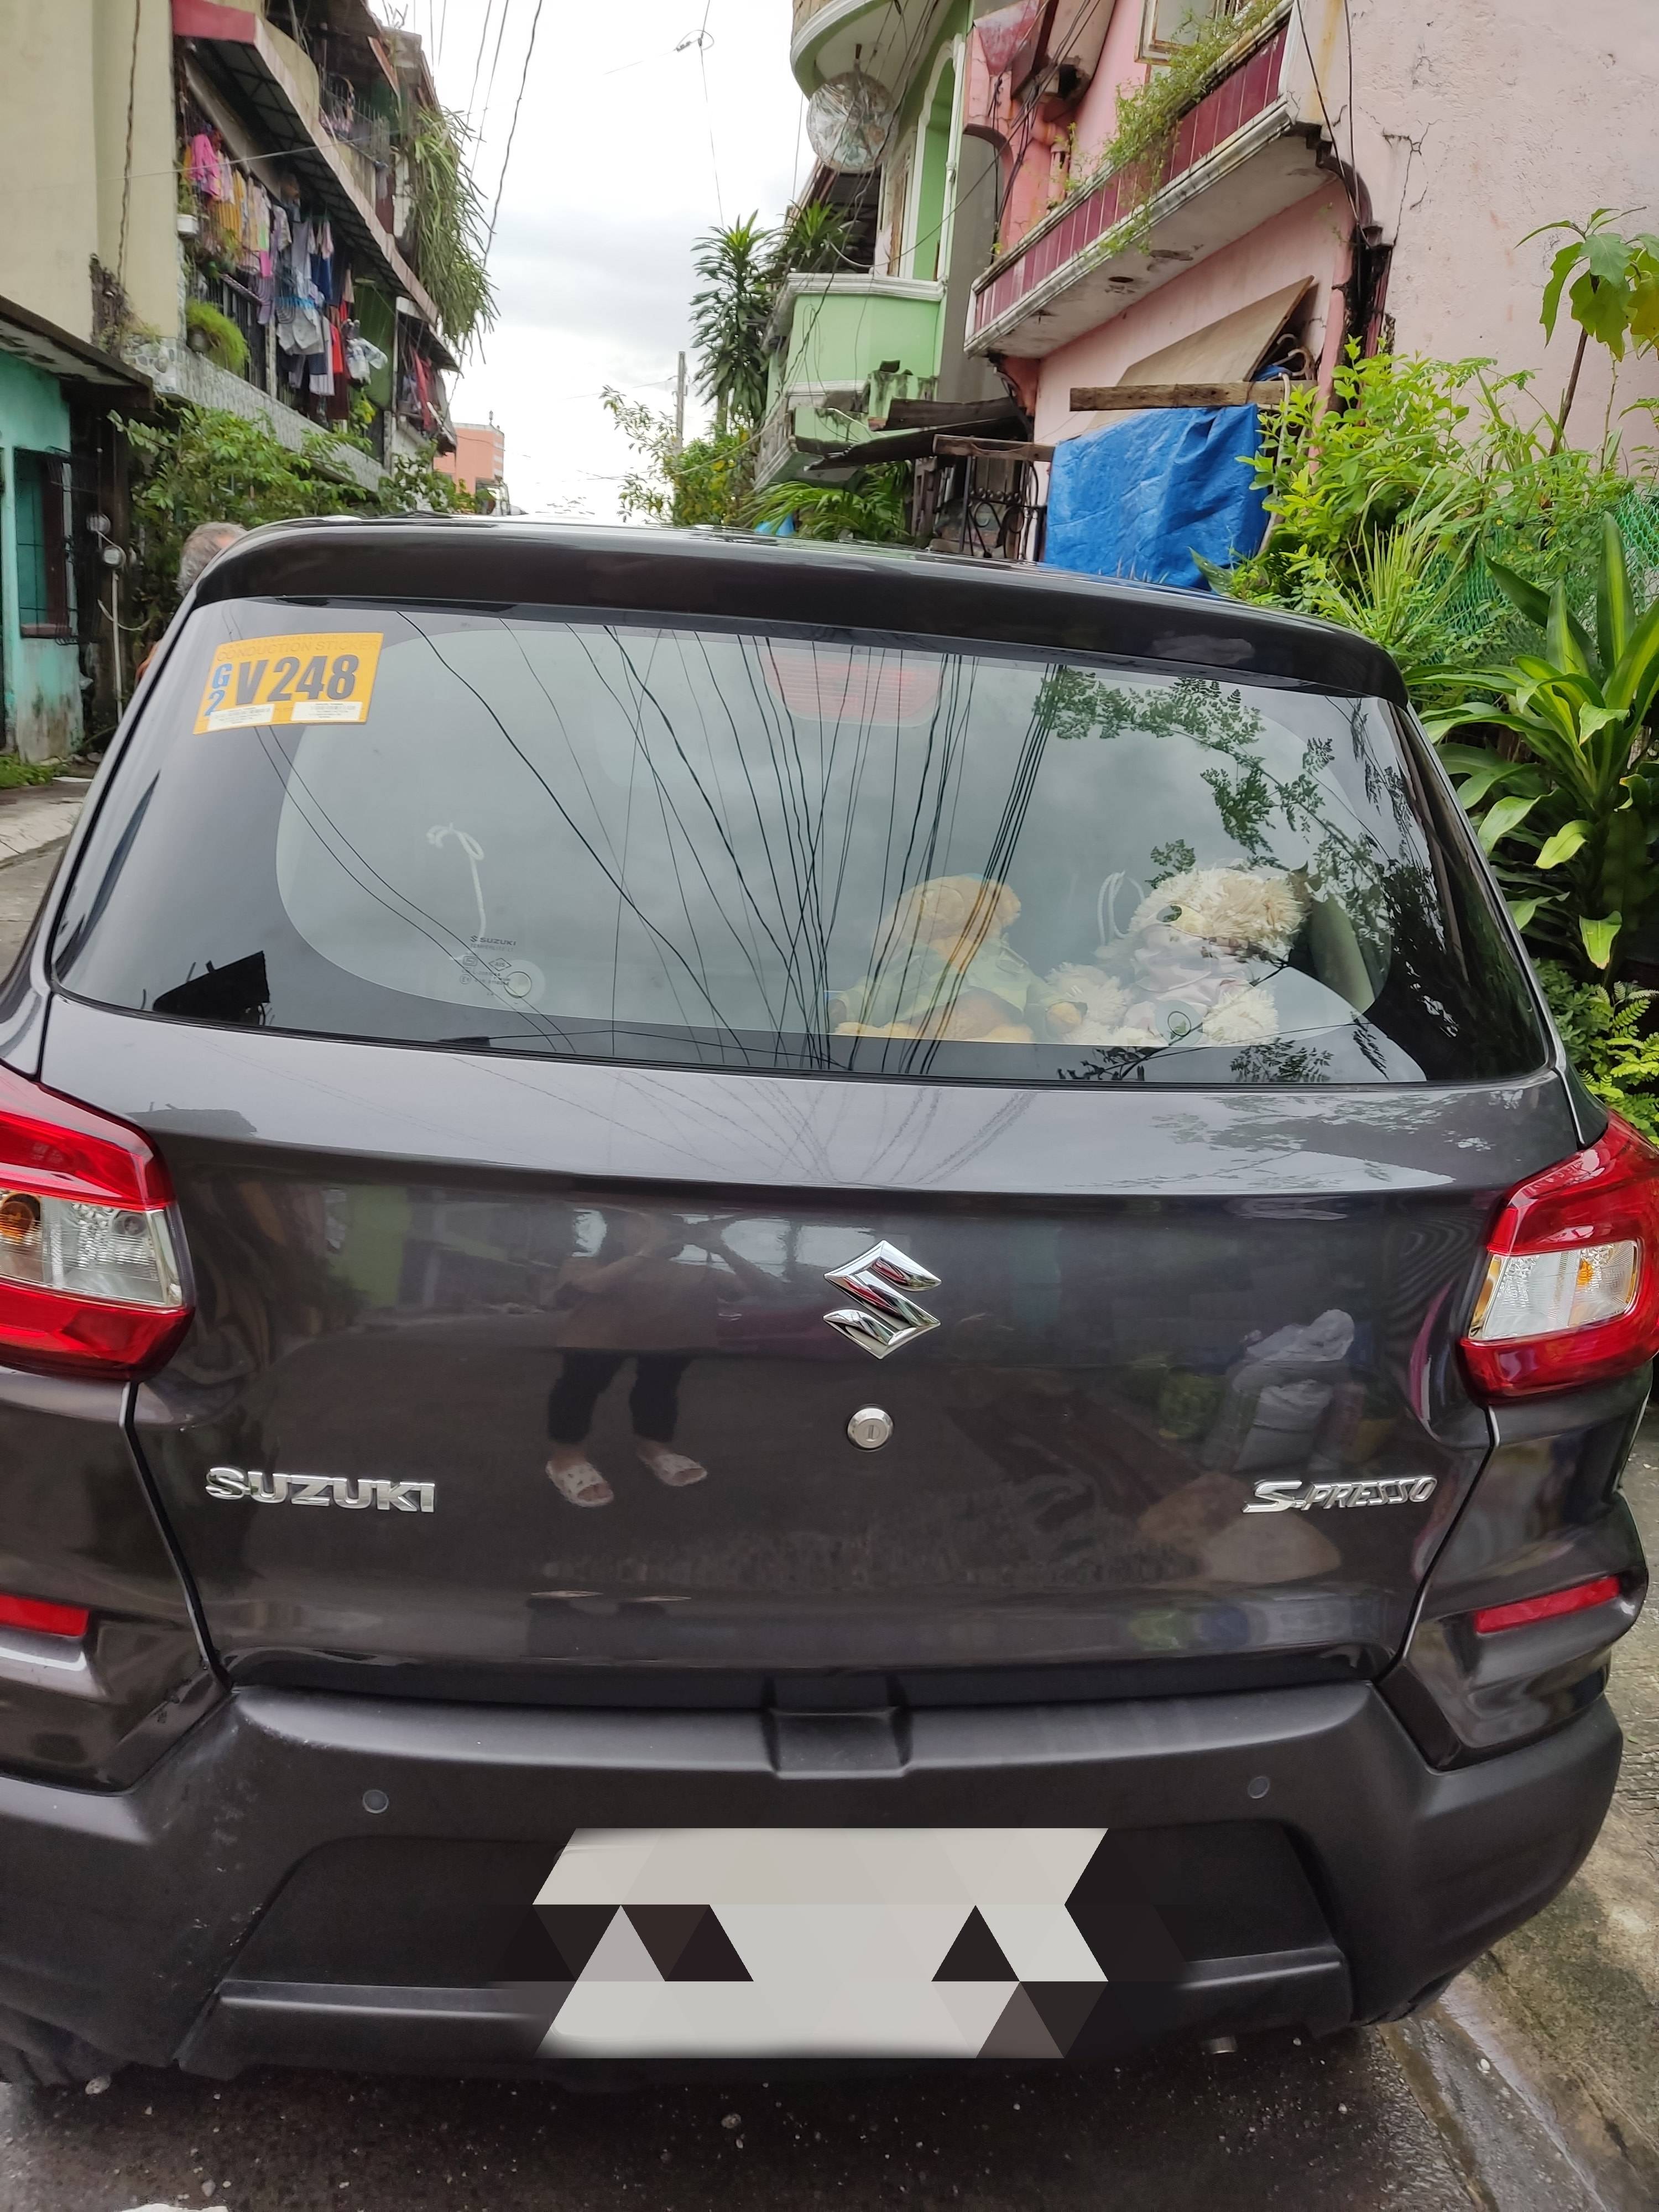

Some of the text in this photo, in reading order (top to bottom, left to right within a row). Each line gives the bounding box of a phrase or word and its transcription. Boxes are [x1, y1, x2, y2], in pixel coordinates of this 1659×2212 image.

[216, 641, 311, 662] CONDUCTION
[314, 640, 380, 651] STICKER
[479, 937, 517, 946] SUZUKI
[205, 1467, 436, 1513] SUZUKI
[1241, 1475, 1438, 1514] S-PRESSO
